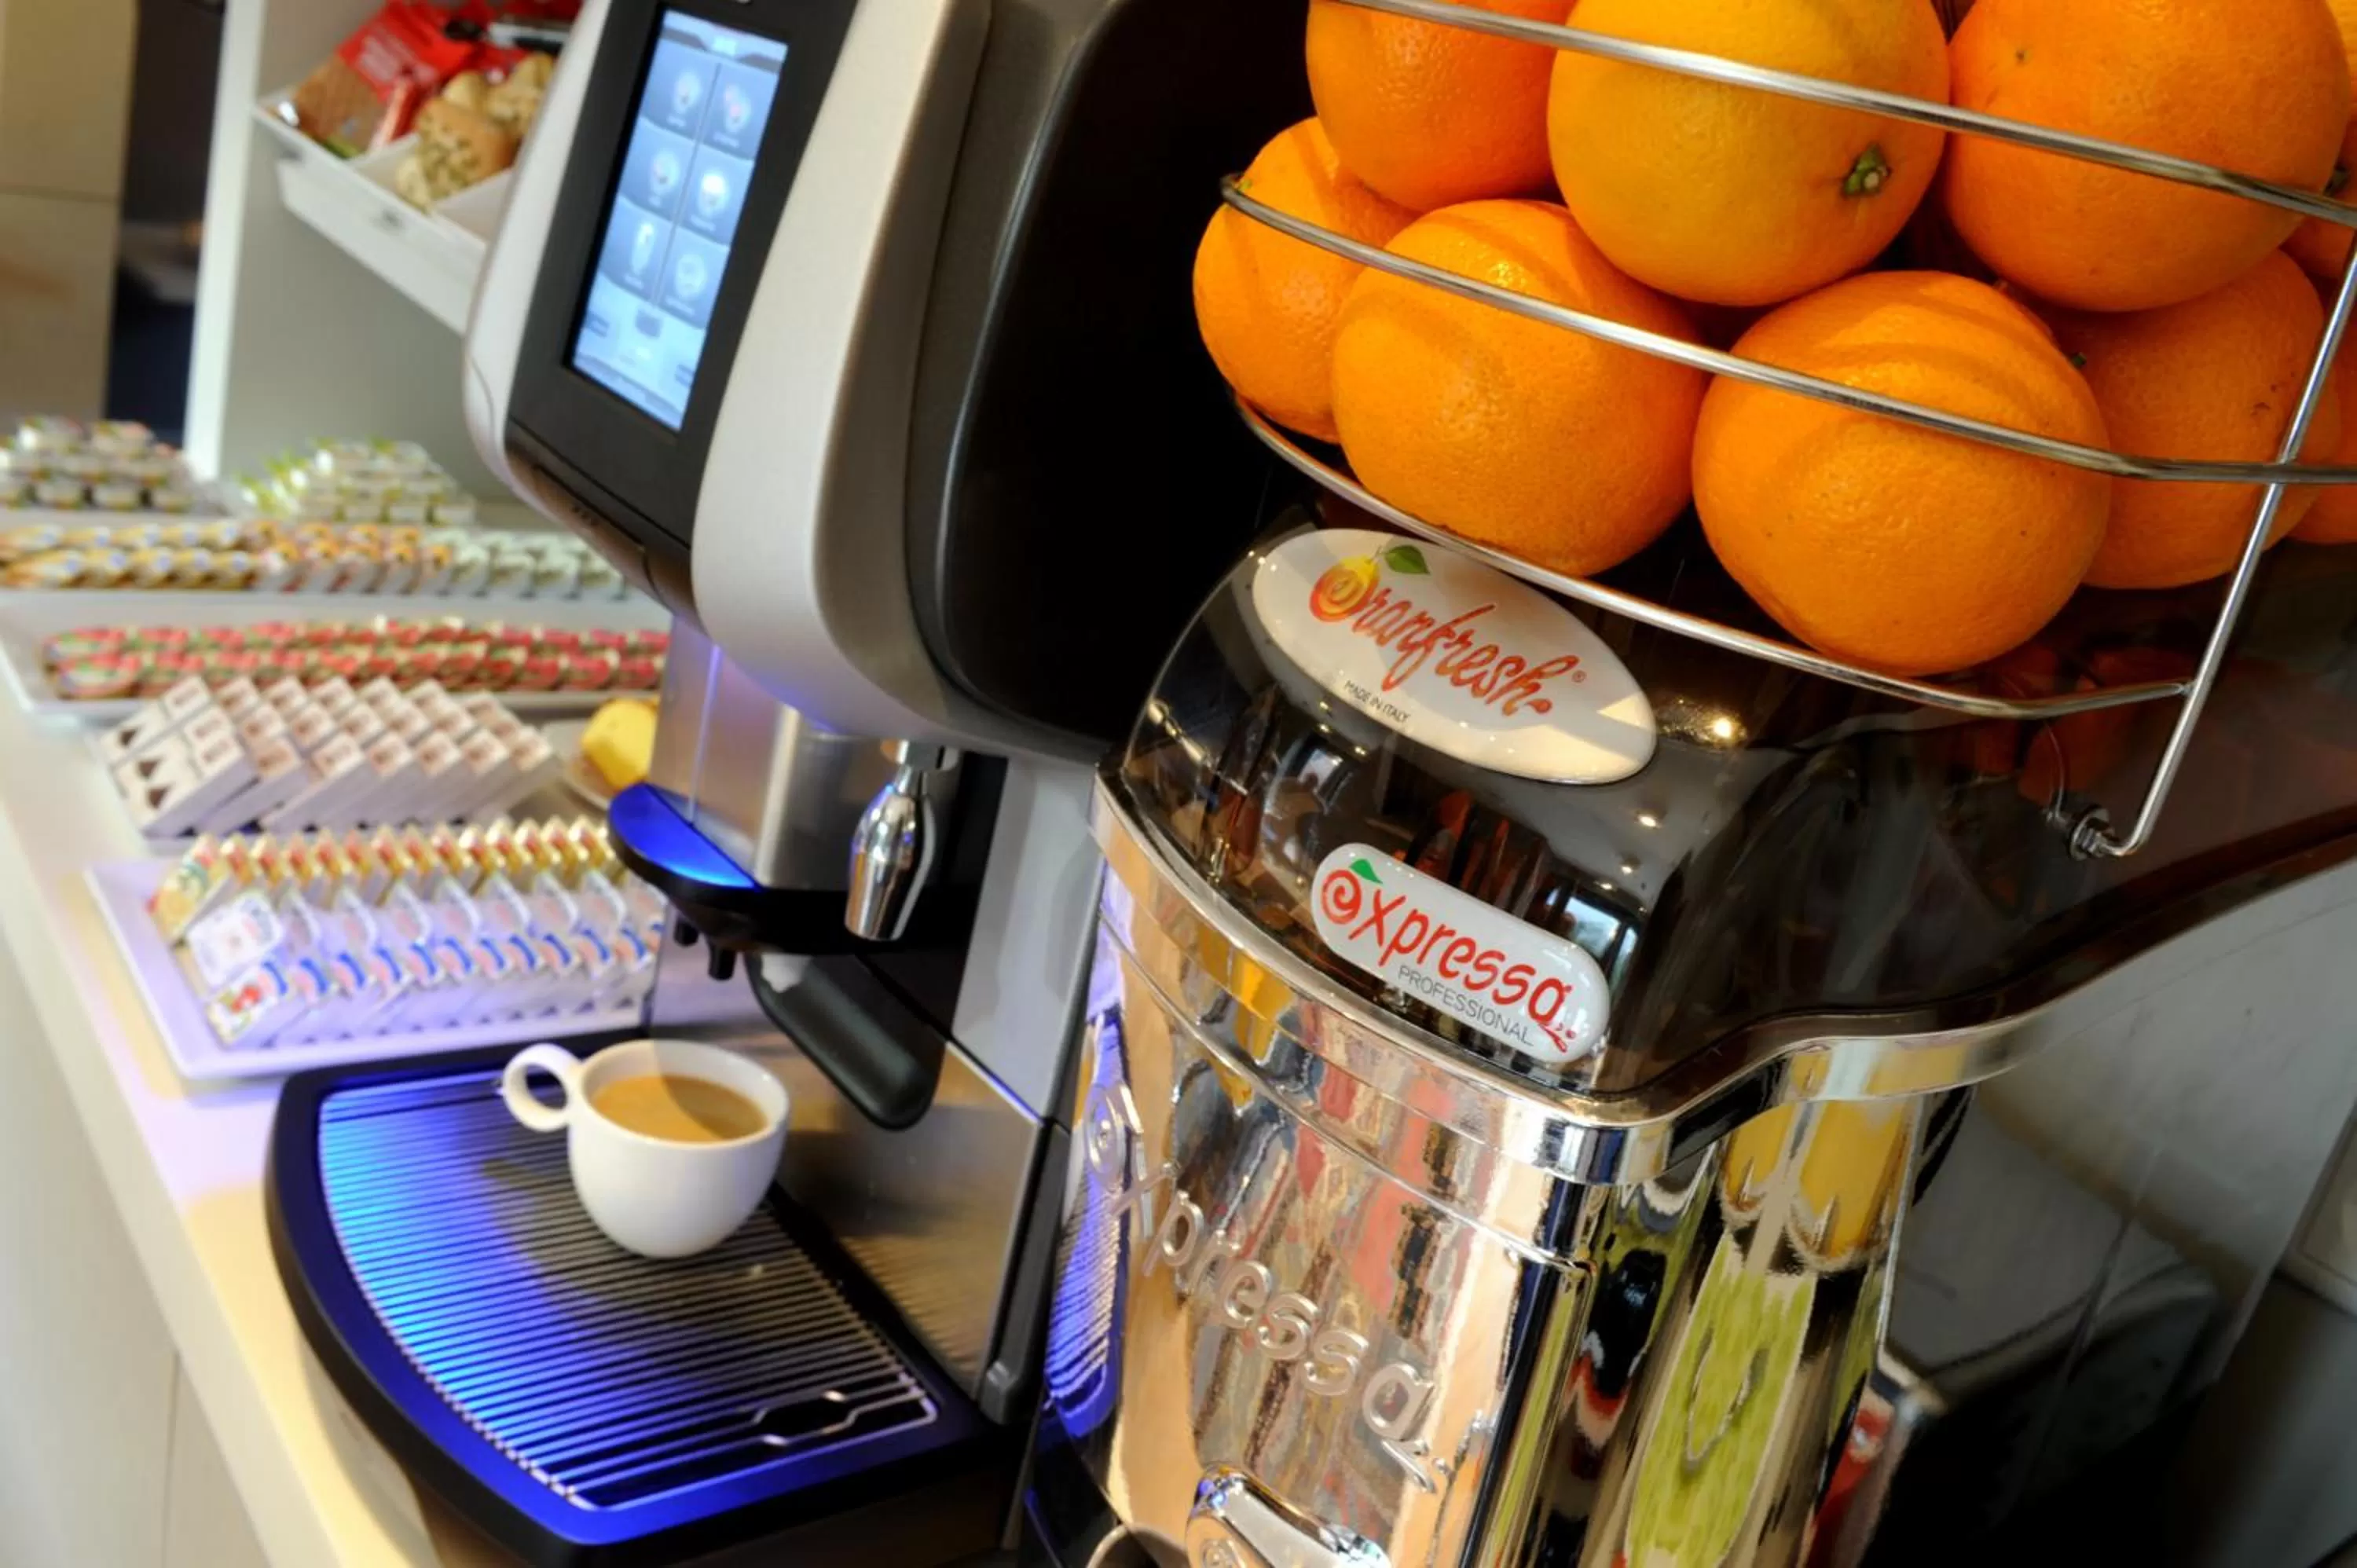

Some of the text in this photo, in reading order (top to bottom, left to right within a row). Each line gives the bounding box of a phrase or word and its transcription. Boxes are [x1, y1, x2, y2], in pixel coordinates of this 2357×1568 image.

[1343, 679, 1370, 702] MADE
[1382, 703, 1412, 723] ITALY
[1398, 965, 1534, 1047] PROFESSIONAL
